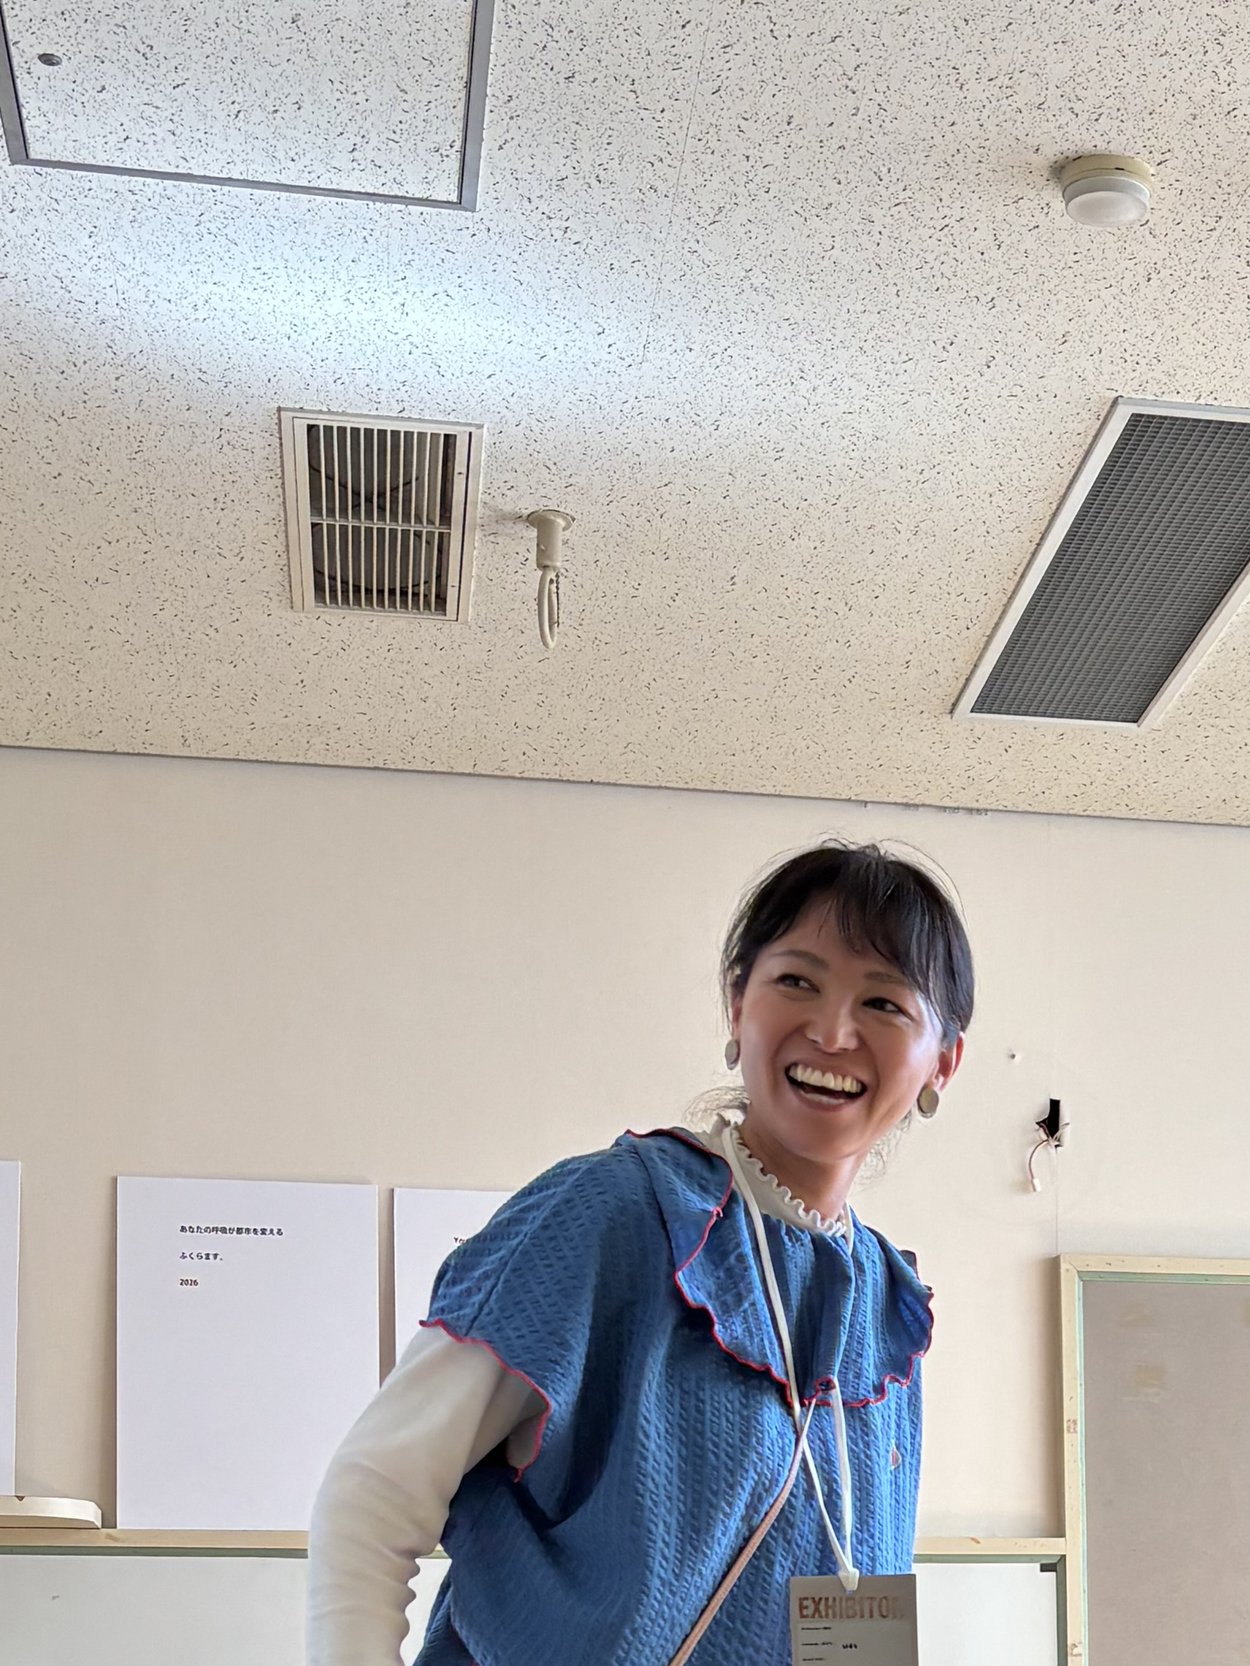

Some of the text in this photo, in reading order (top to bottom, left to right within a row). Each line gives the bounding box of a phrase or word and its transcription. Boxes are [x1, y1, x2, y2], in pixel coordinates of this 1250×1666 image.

[179, 1251, 223, 1261] ふくらます。
